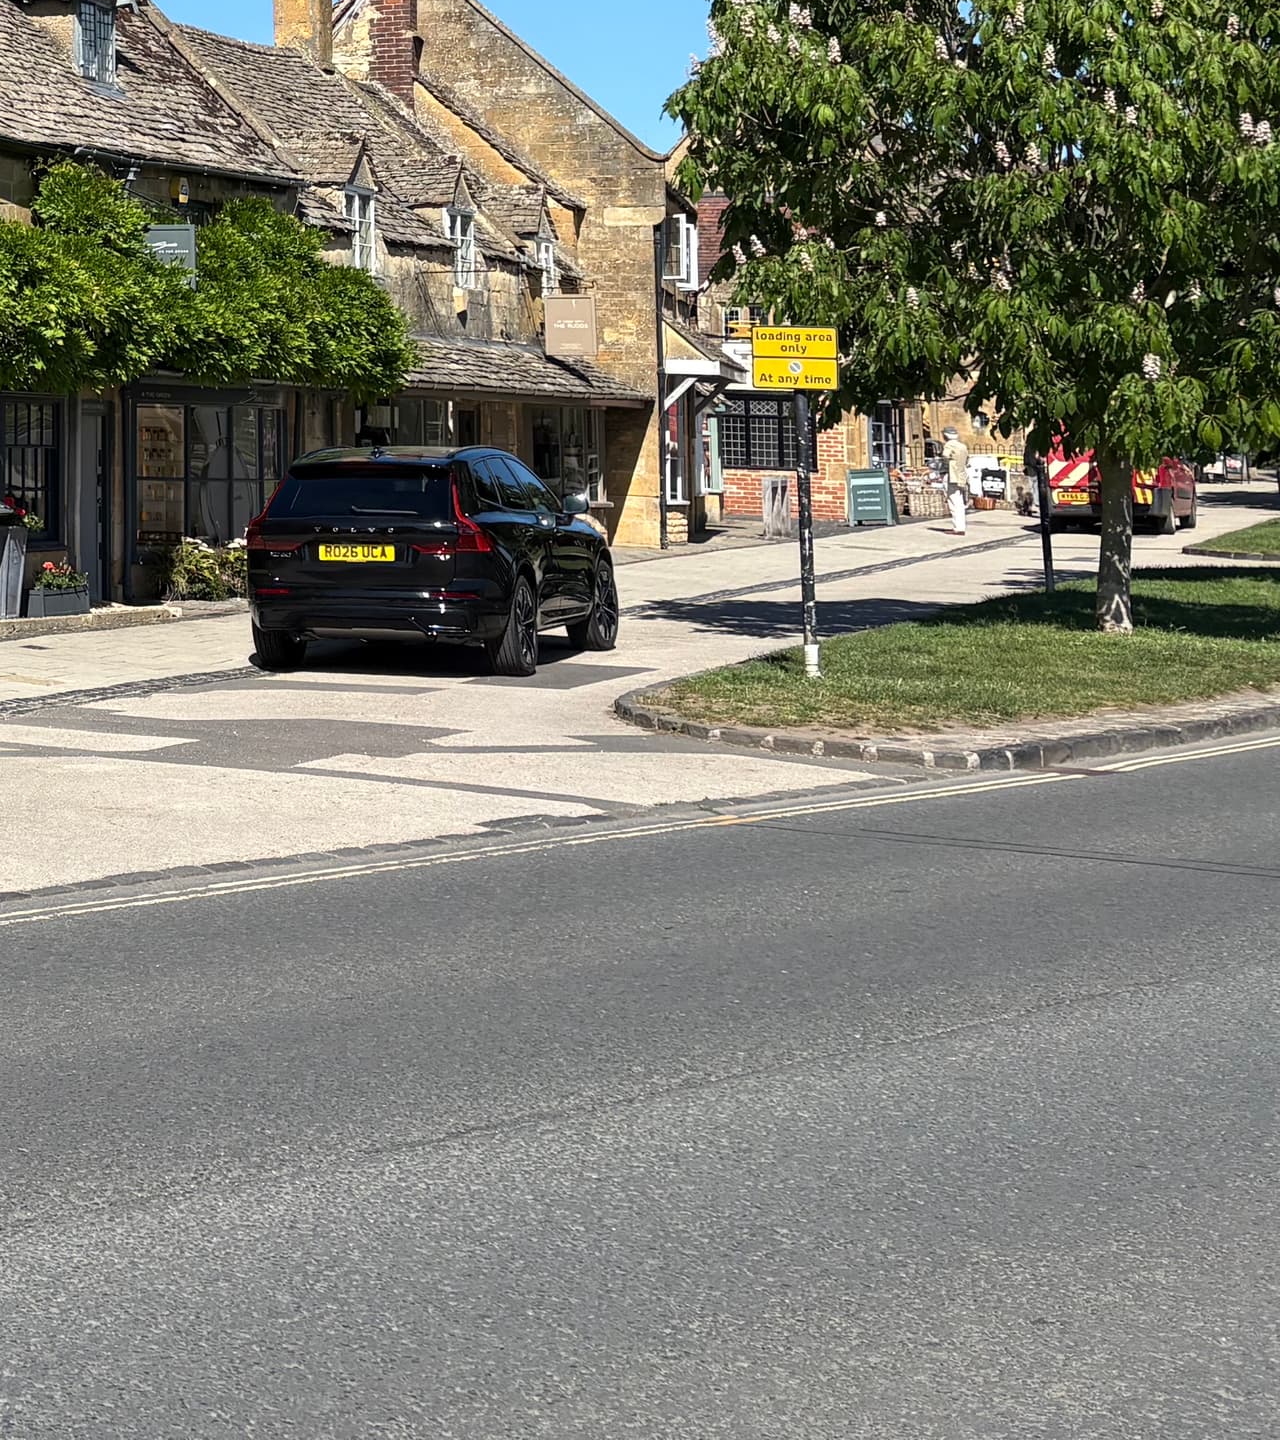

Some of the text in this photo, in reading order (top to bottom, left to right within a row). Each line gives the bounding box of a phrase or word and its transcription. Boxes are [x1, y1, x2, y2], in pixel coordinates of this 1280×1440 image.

[756, 331, 832, 342] loading area
[780, 344, 807, 354] only
[760, 373, 831, 385] At any time
[325, 544, 387, 559] RO26 UCA
